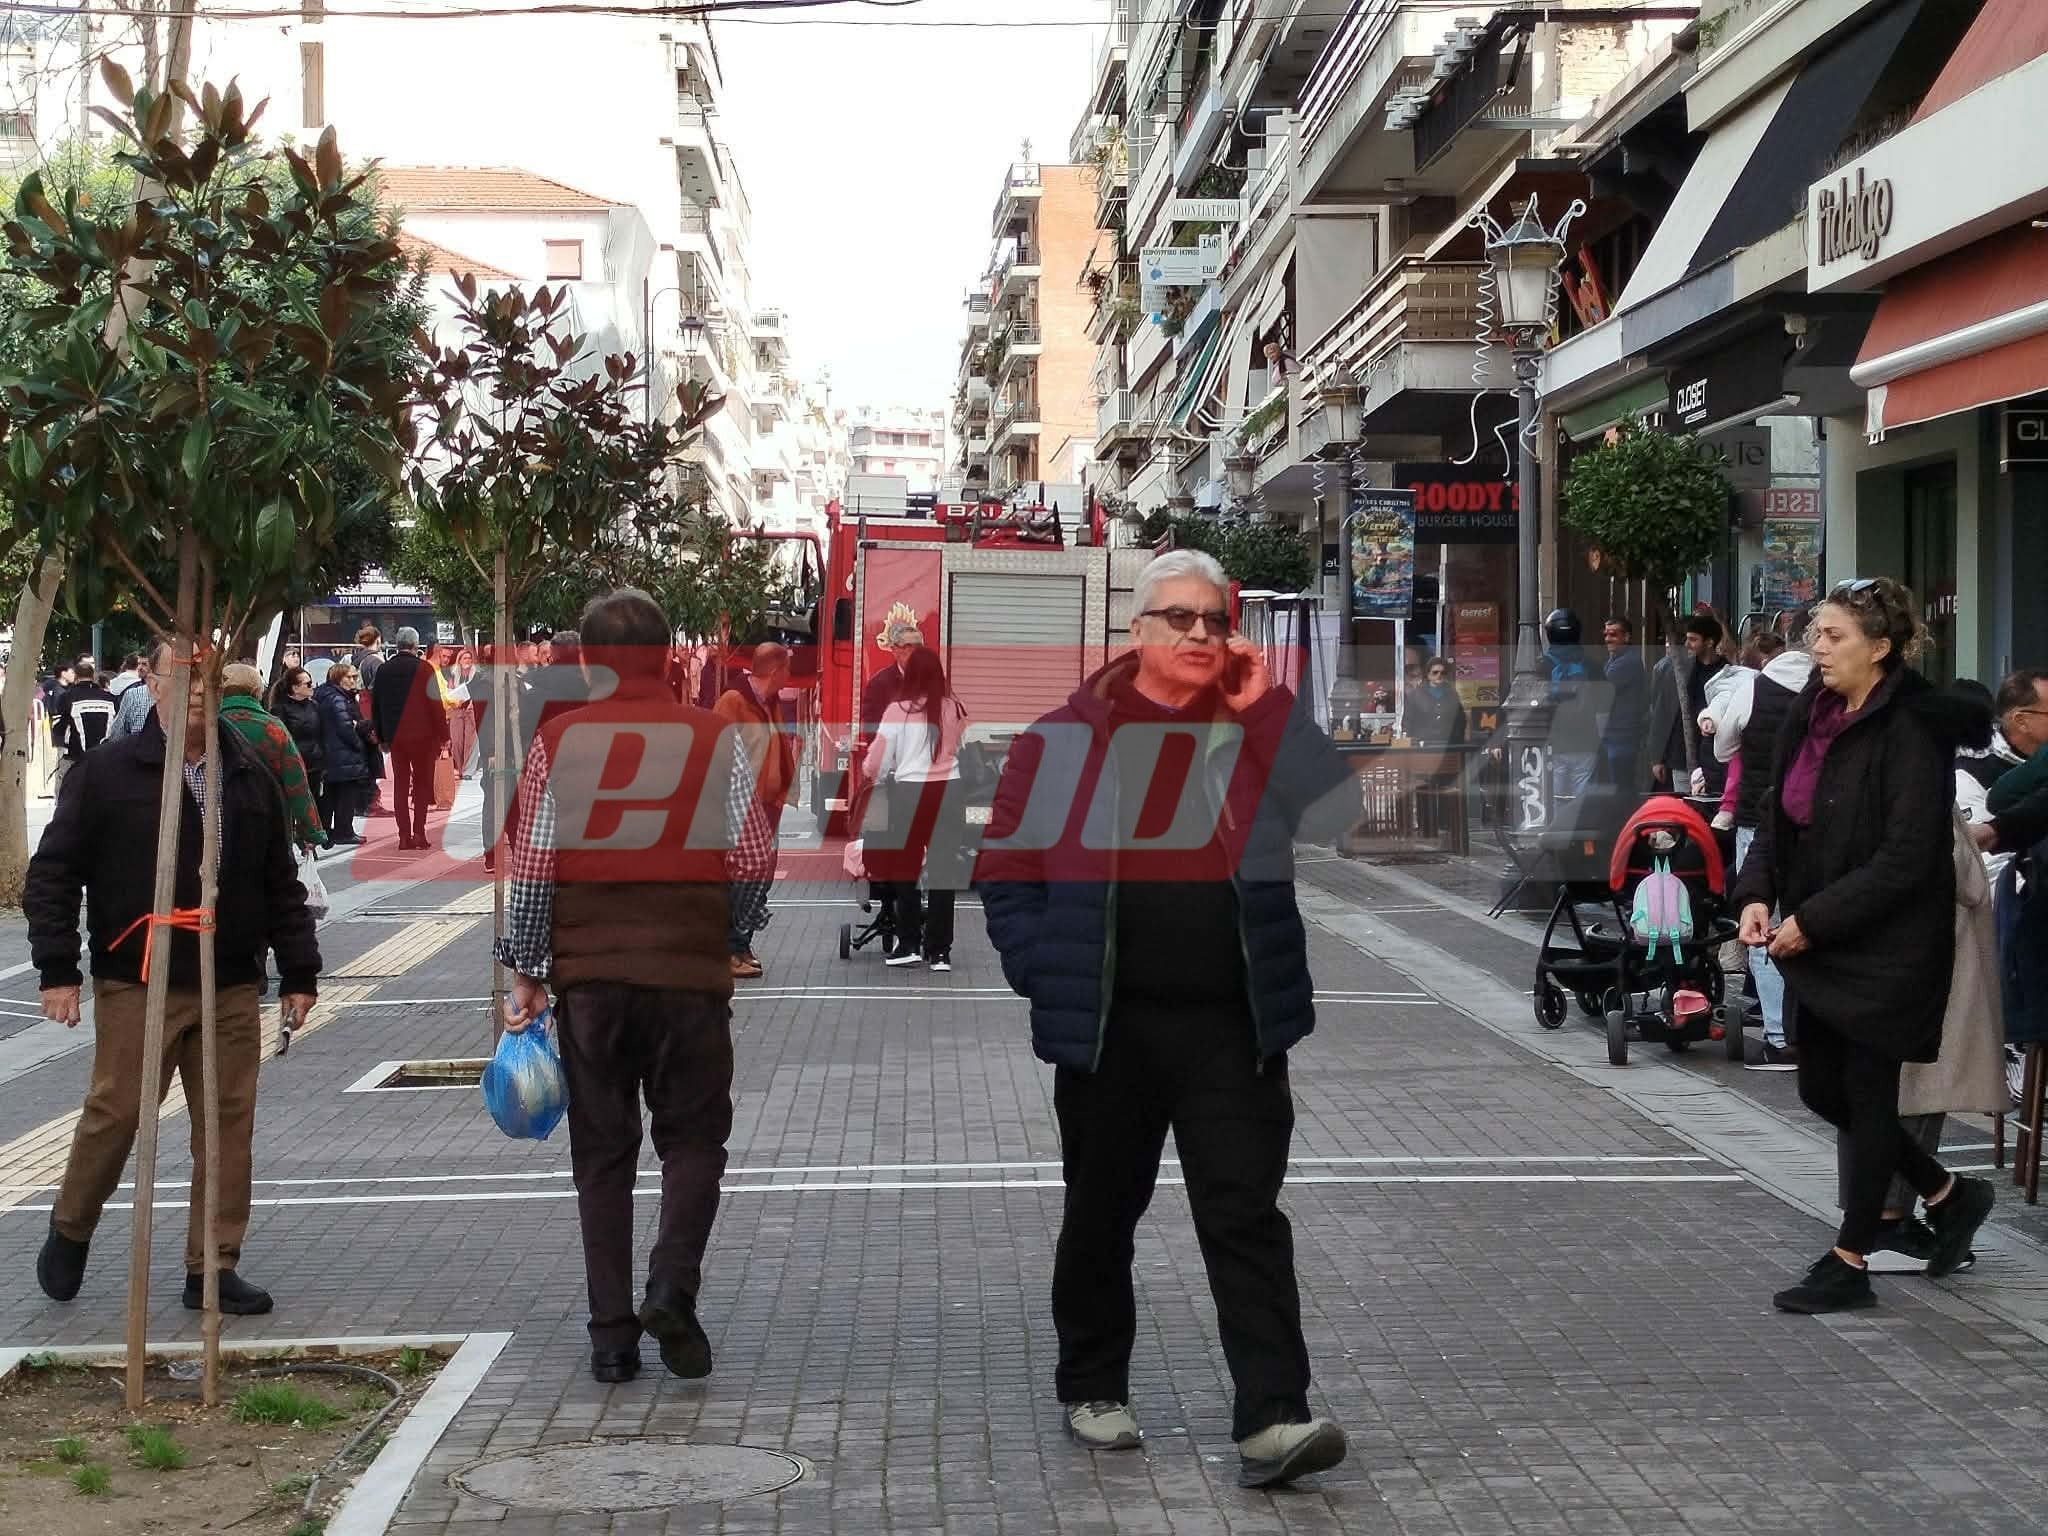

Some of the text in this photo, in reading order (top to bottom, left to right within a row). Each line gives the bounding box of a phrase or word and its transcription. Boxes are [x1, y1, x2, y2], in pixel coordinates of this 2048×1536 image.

[1818, 168, 1893, 266] fidalgo
[1677, 378, 1708, 415] CLOSET
[1417, 513, 1466, 528] BURGER
[1472, 512, 1516, 527] HOUSE
[349, 596, 360, 604] RED
[361, 596, 375, 604] BULL
